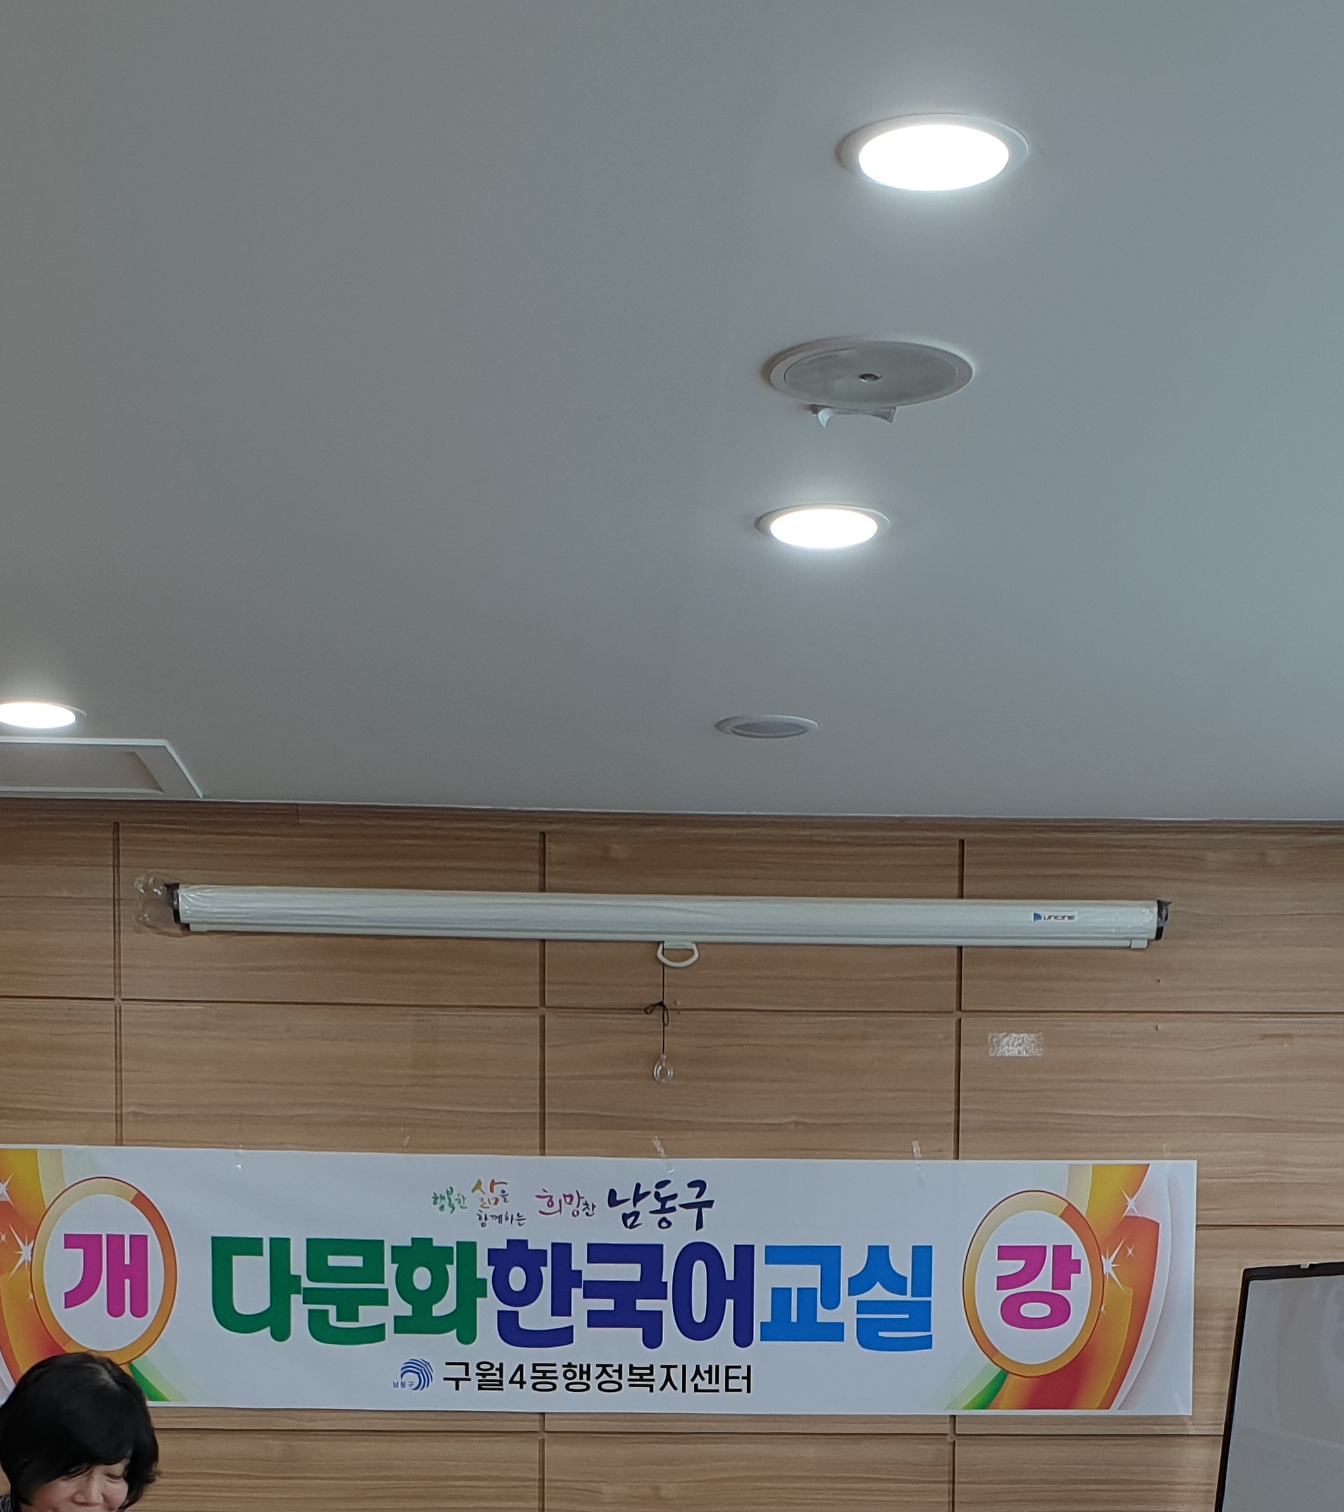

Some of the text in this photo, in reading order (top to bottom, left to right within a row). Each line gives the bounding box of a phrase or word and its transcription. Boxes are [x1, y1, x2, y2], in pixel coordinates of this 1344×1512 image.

[432, 1178, 509, 1214] 행복한 삶을
[535, 1180, 715, 1231] 희망찬 남동구
[476, 1211, 527, 1228] 함께하는
[64, 1233, 149, 1319] 개
[996, 1244, 1082, 1330] 강
[442, 1360, 753, 1394] 구월4동행정복지센터
